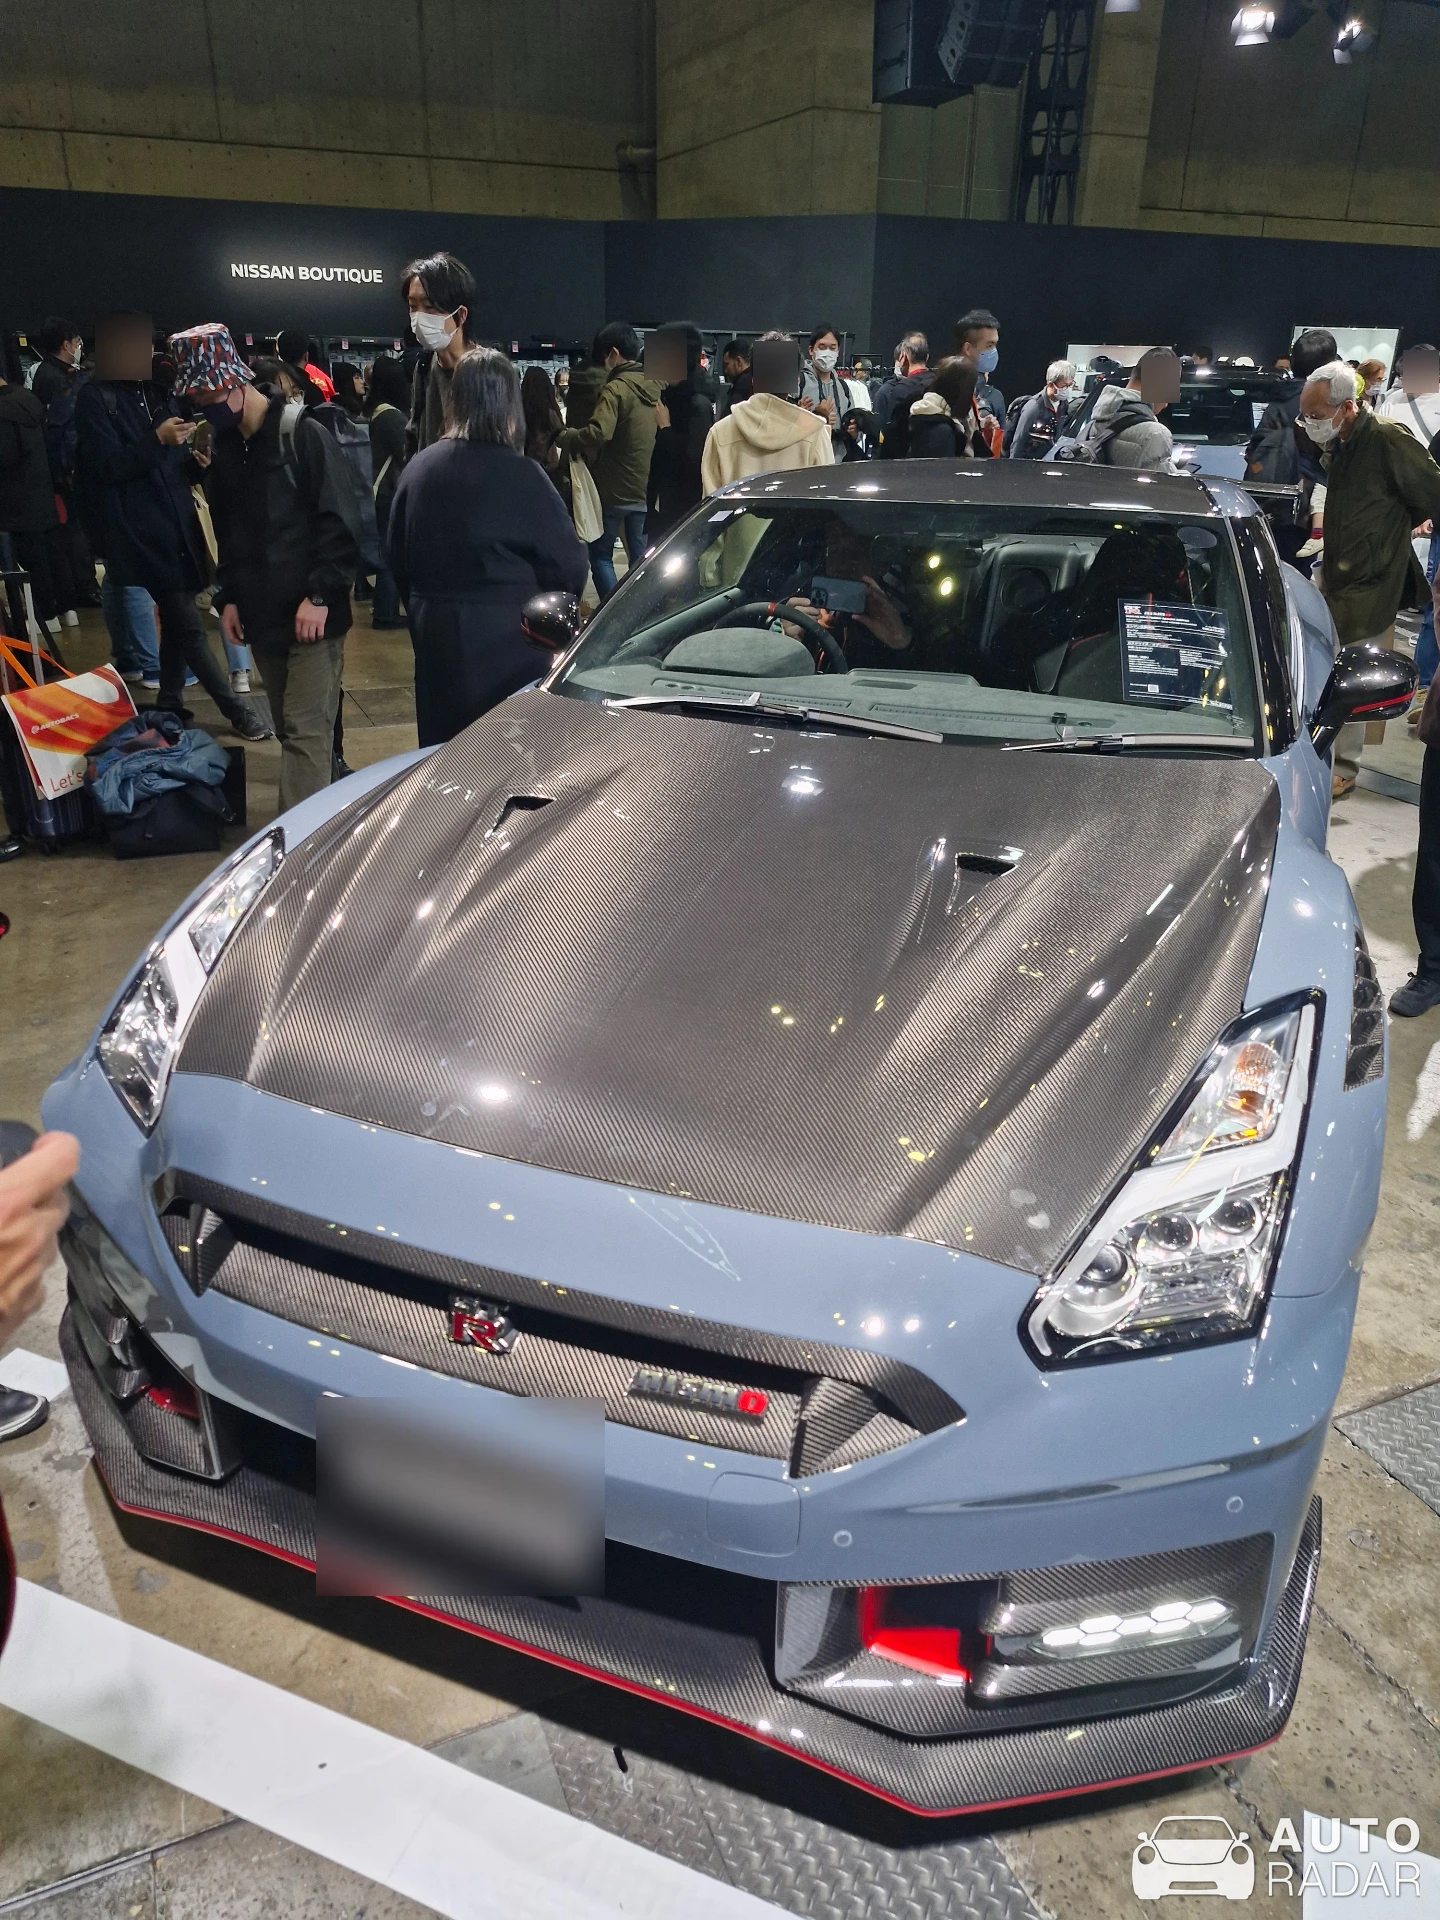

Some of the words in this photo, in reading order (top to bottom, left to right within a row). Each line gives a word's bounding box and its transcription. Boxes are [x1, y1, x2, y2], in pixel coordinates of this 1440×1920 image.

[231, 263, 295, 280] NISSAN
[298, 266, 383, 283] BOUTIQUE
[39, 713, 79, 731] AUTOBACS
[50, 770, 84, 792] Let's
